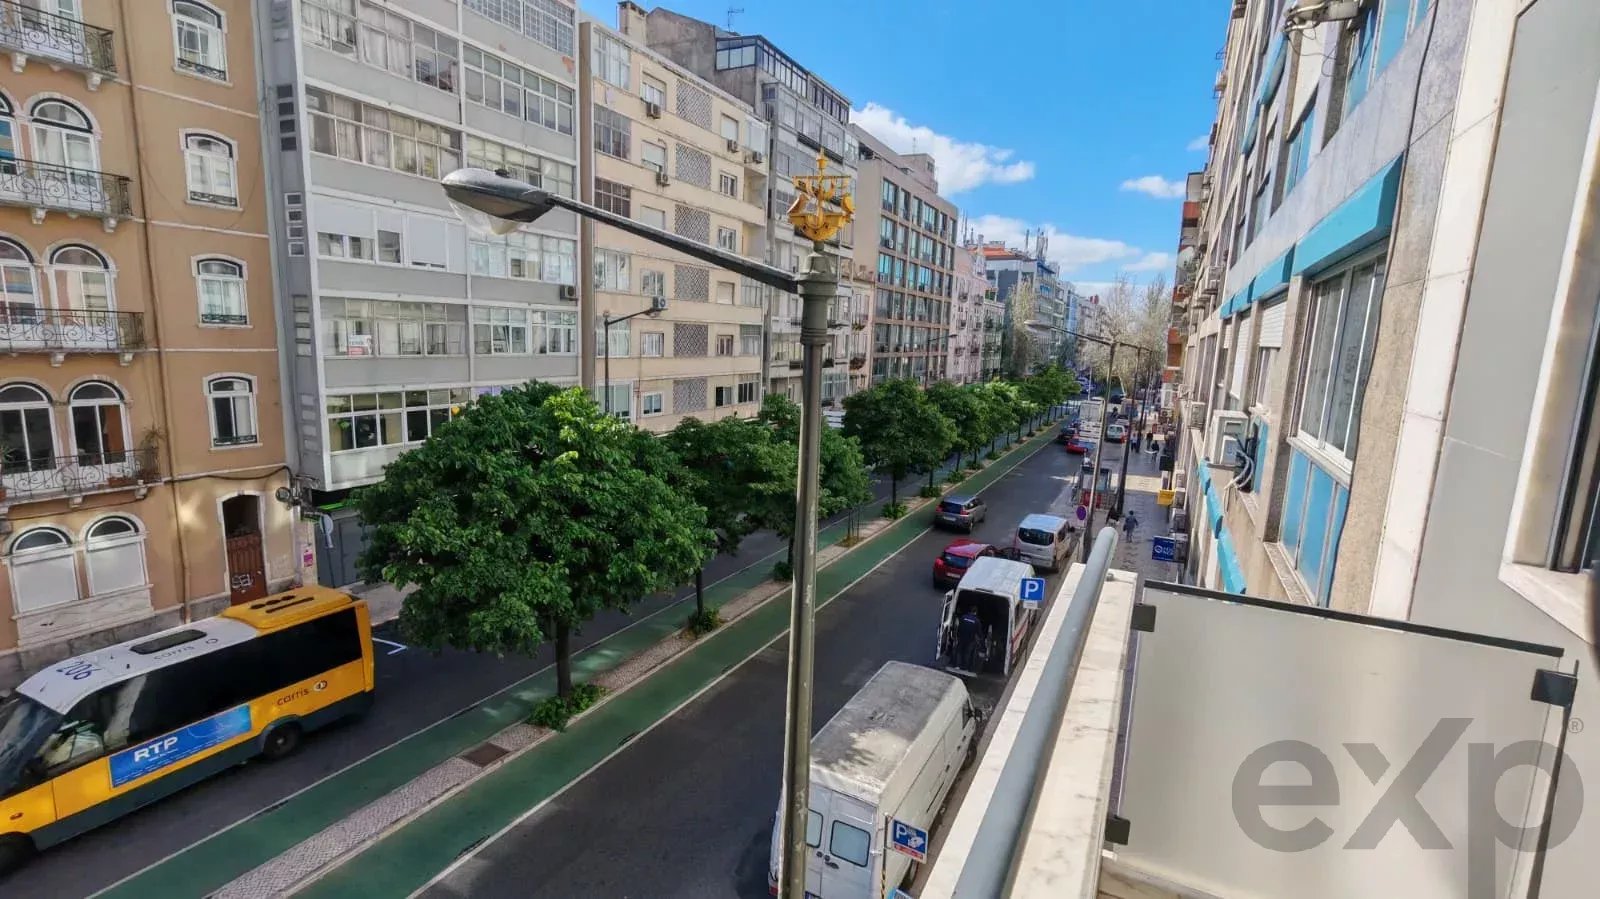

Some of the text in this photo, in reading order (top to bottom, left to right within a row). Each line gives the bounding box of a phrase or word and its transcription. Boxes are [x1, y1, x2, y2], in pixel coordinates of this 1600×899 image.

[1025, 580, 1039, 598] P
[276, 687, 310, 706] carris
[133, 736, 179, 763] RTP
[896, 823, 907, 839] P
